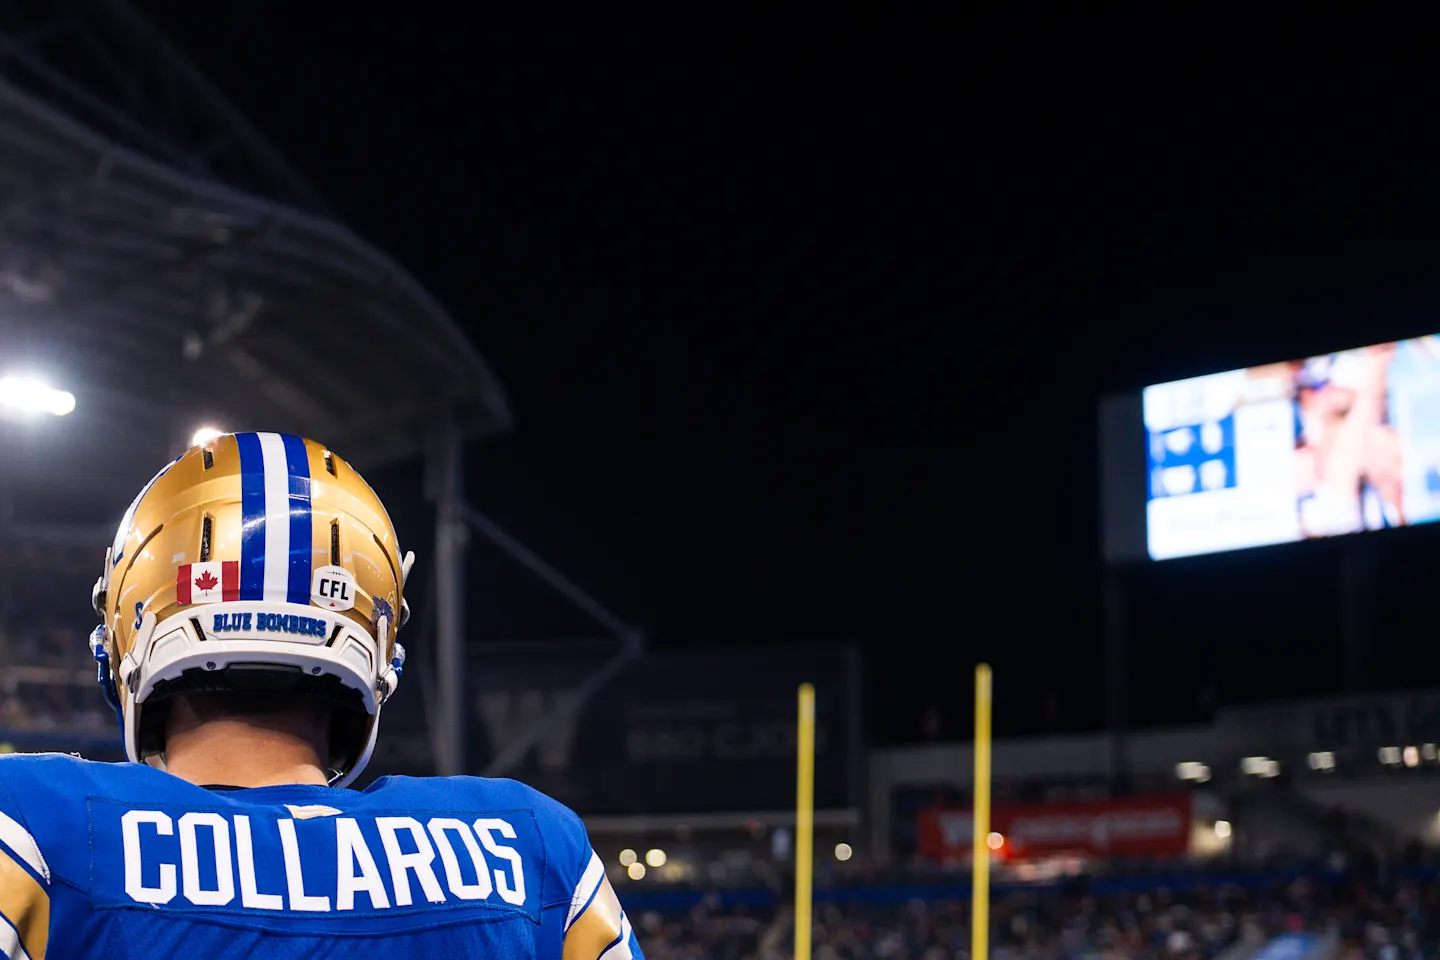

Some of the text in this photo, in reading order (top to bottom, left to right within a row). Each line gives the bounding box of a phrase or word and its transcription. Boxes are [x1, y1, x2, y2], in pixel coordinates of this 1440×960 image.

[319, 578, 349, 601] CFL
[213, 612, 327, 637] BLUE BOMBERS
[121, 809, 527, 912] COLLAROS
